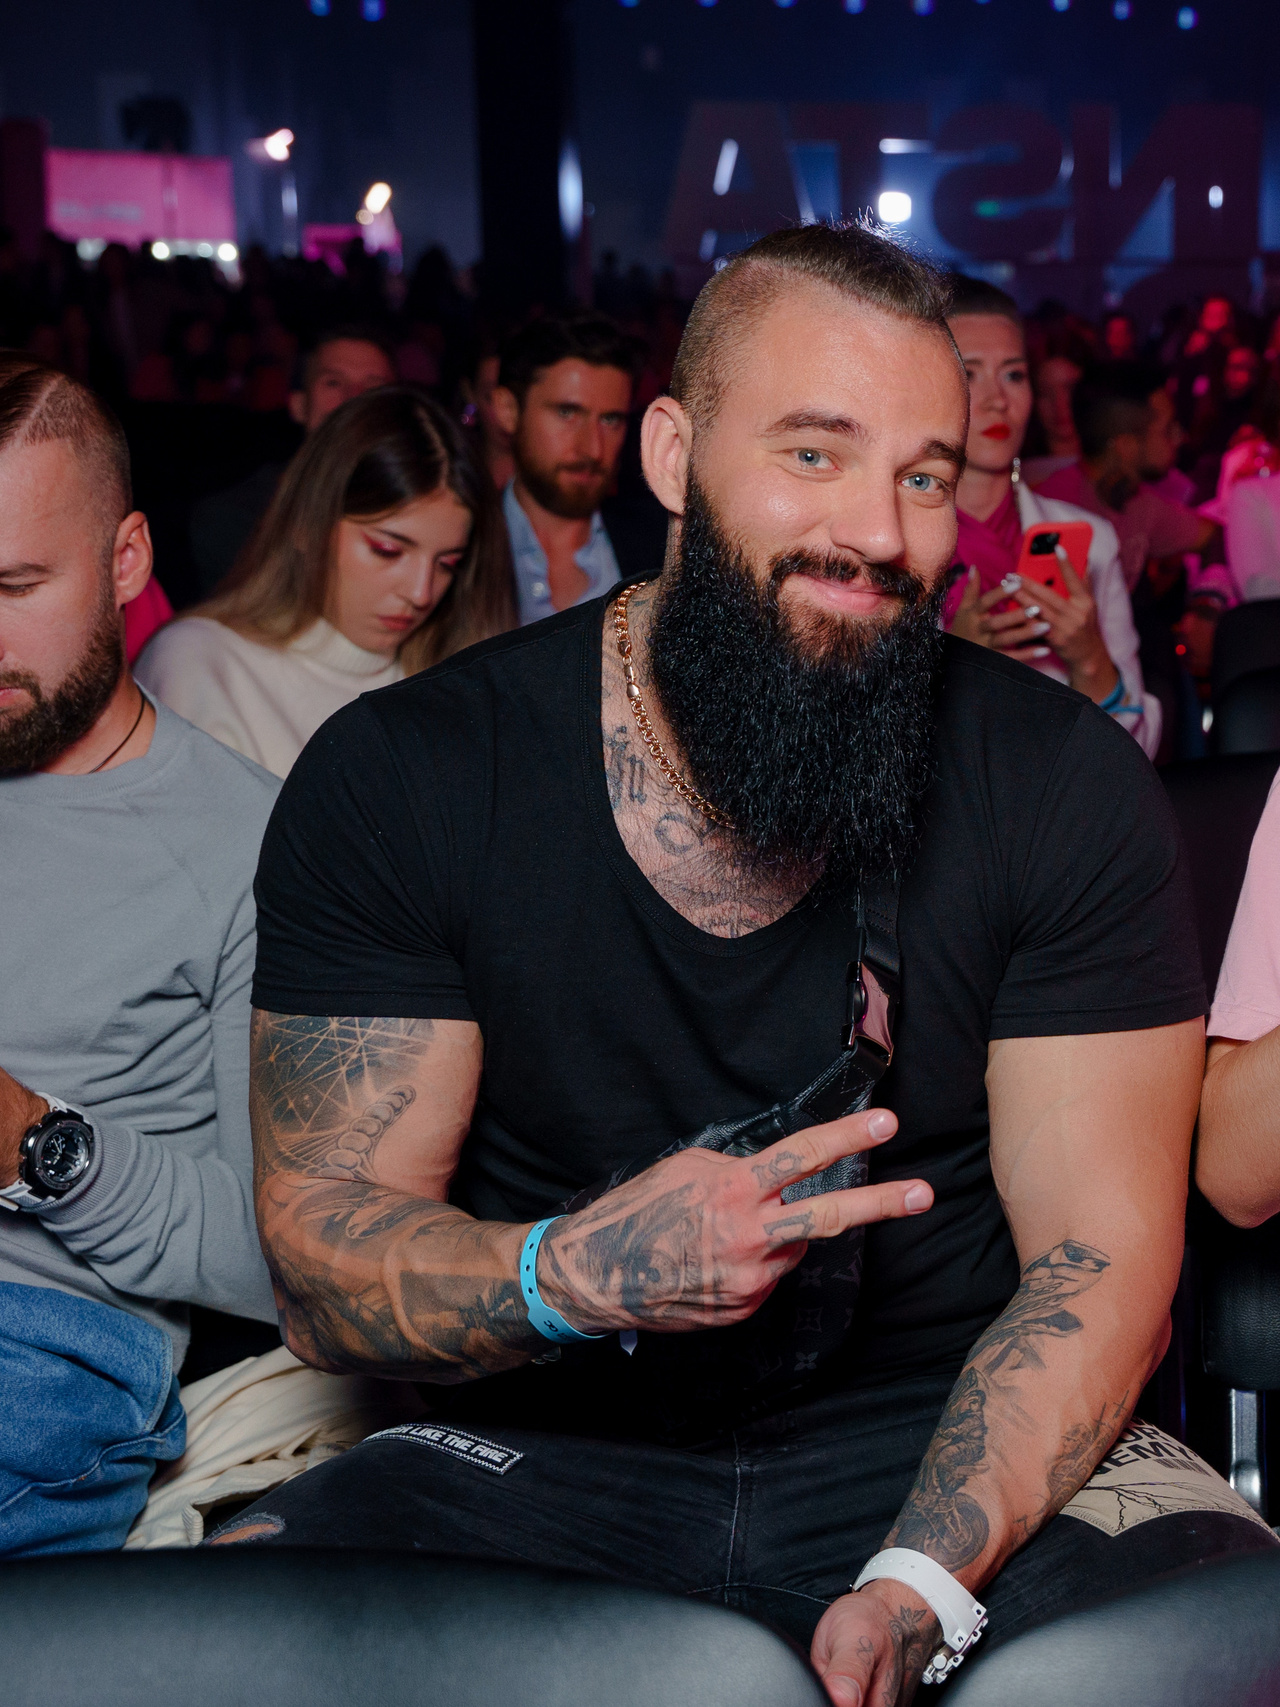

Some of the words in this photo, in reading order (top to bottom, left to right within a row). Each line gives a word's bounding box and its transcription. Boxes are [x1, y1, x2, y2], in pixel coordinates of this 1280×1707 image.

[409, 1426, 447, 1441] LIKE
[442, 1433, 476, 1451] THE
[470, 1444, 508, 1463] FIRE
